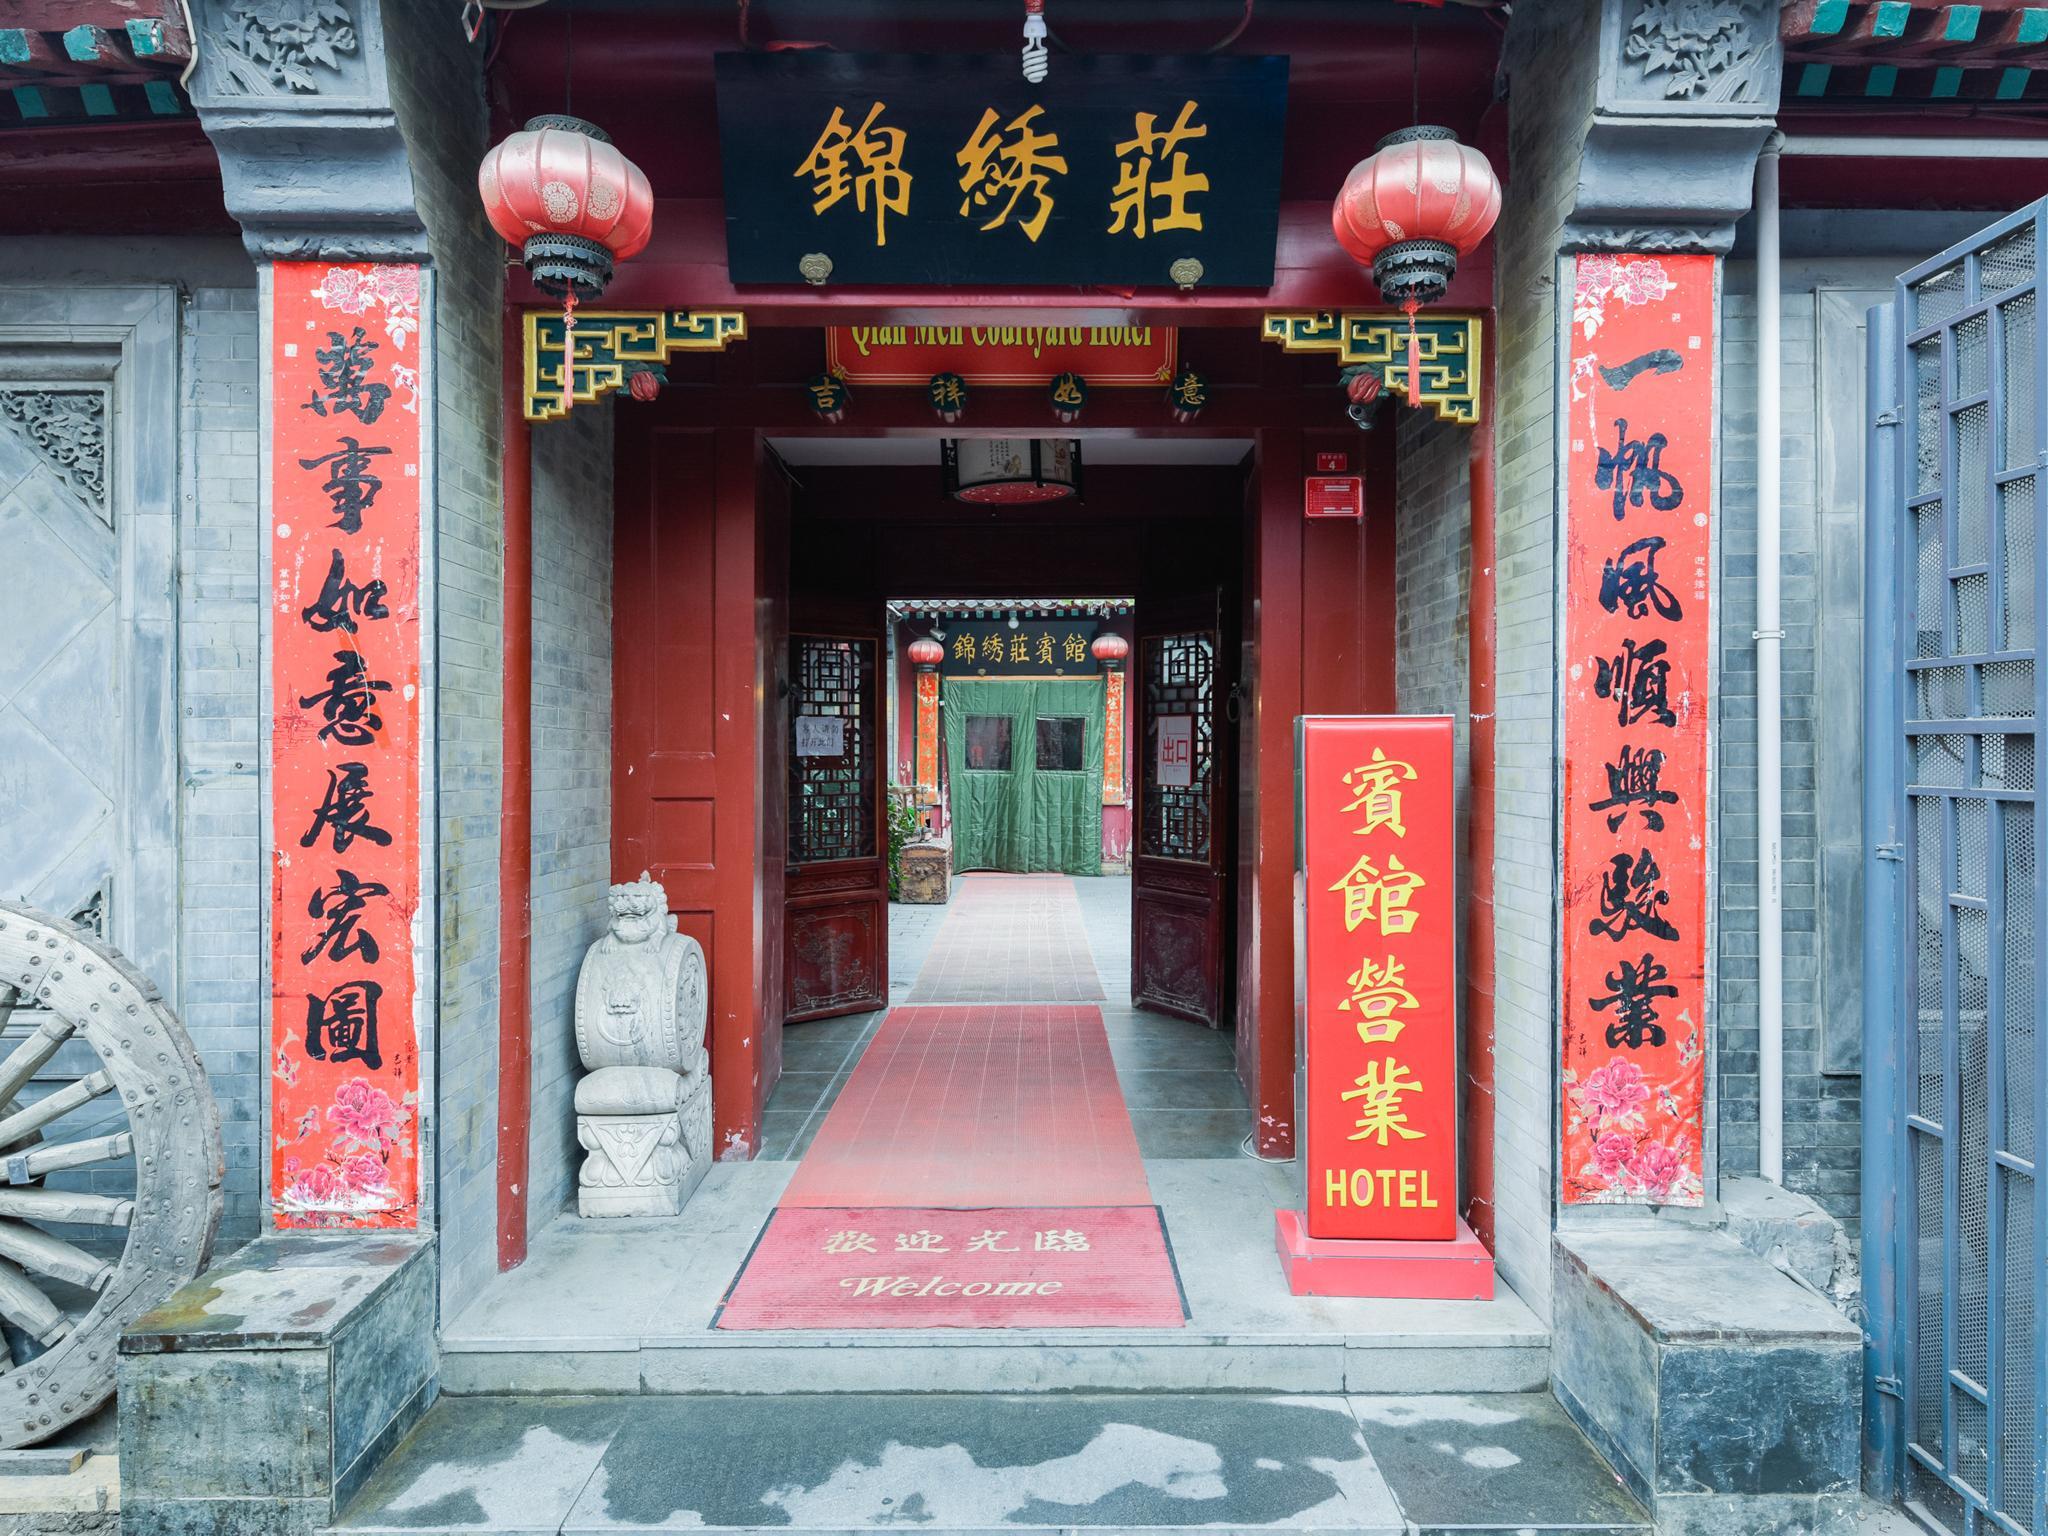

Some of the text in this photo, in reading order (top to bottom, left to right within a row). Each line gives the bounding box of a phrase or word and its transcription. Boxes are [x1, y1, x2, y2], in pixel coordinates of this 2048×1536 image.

[1162, 736, 1189, 764] 出口
[1328, 746, 1427, 1147] 賓館營業
[1325, 1168, 1439, 1209] HOTEL
[839, 1275, 1064, 1298] Welcome
